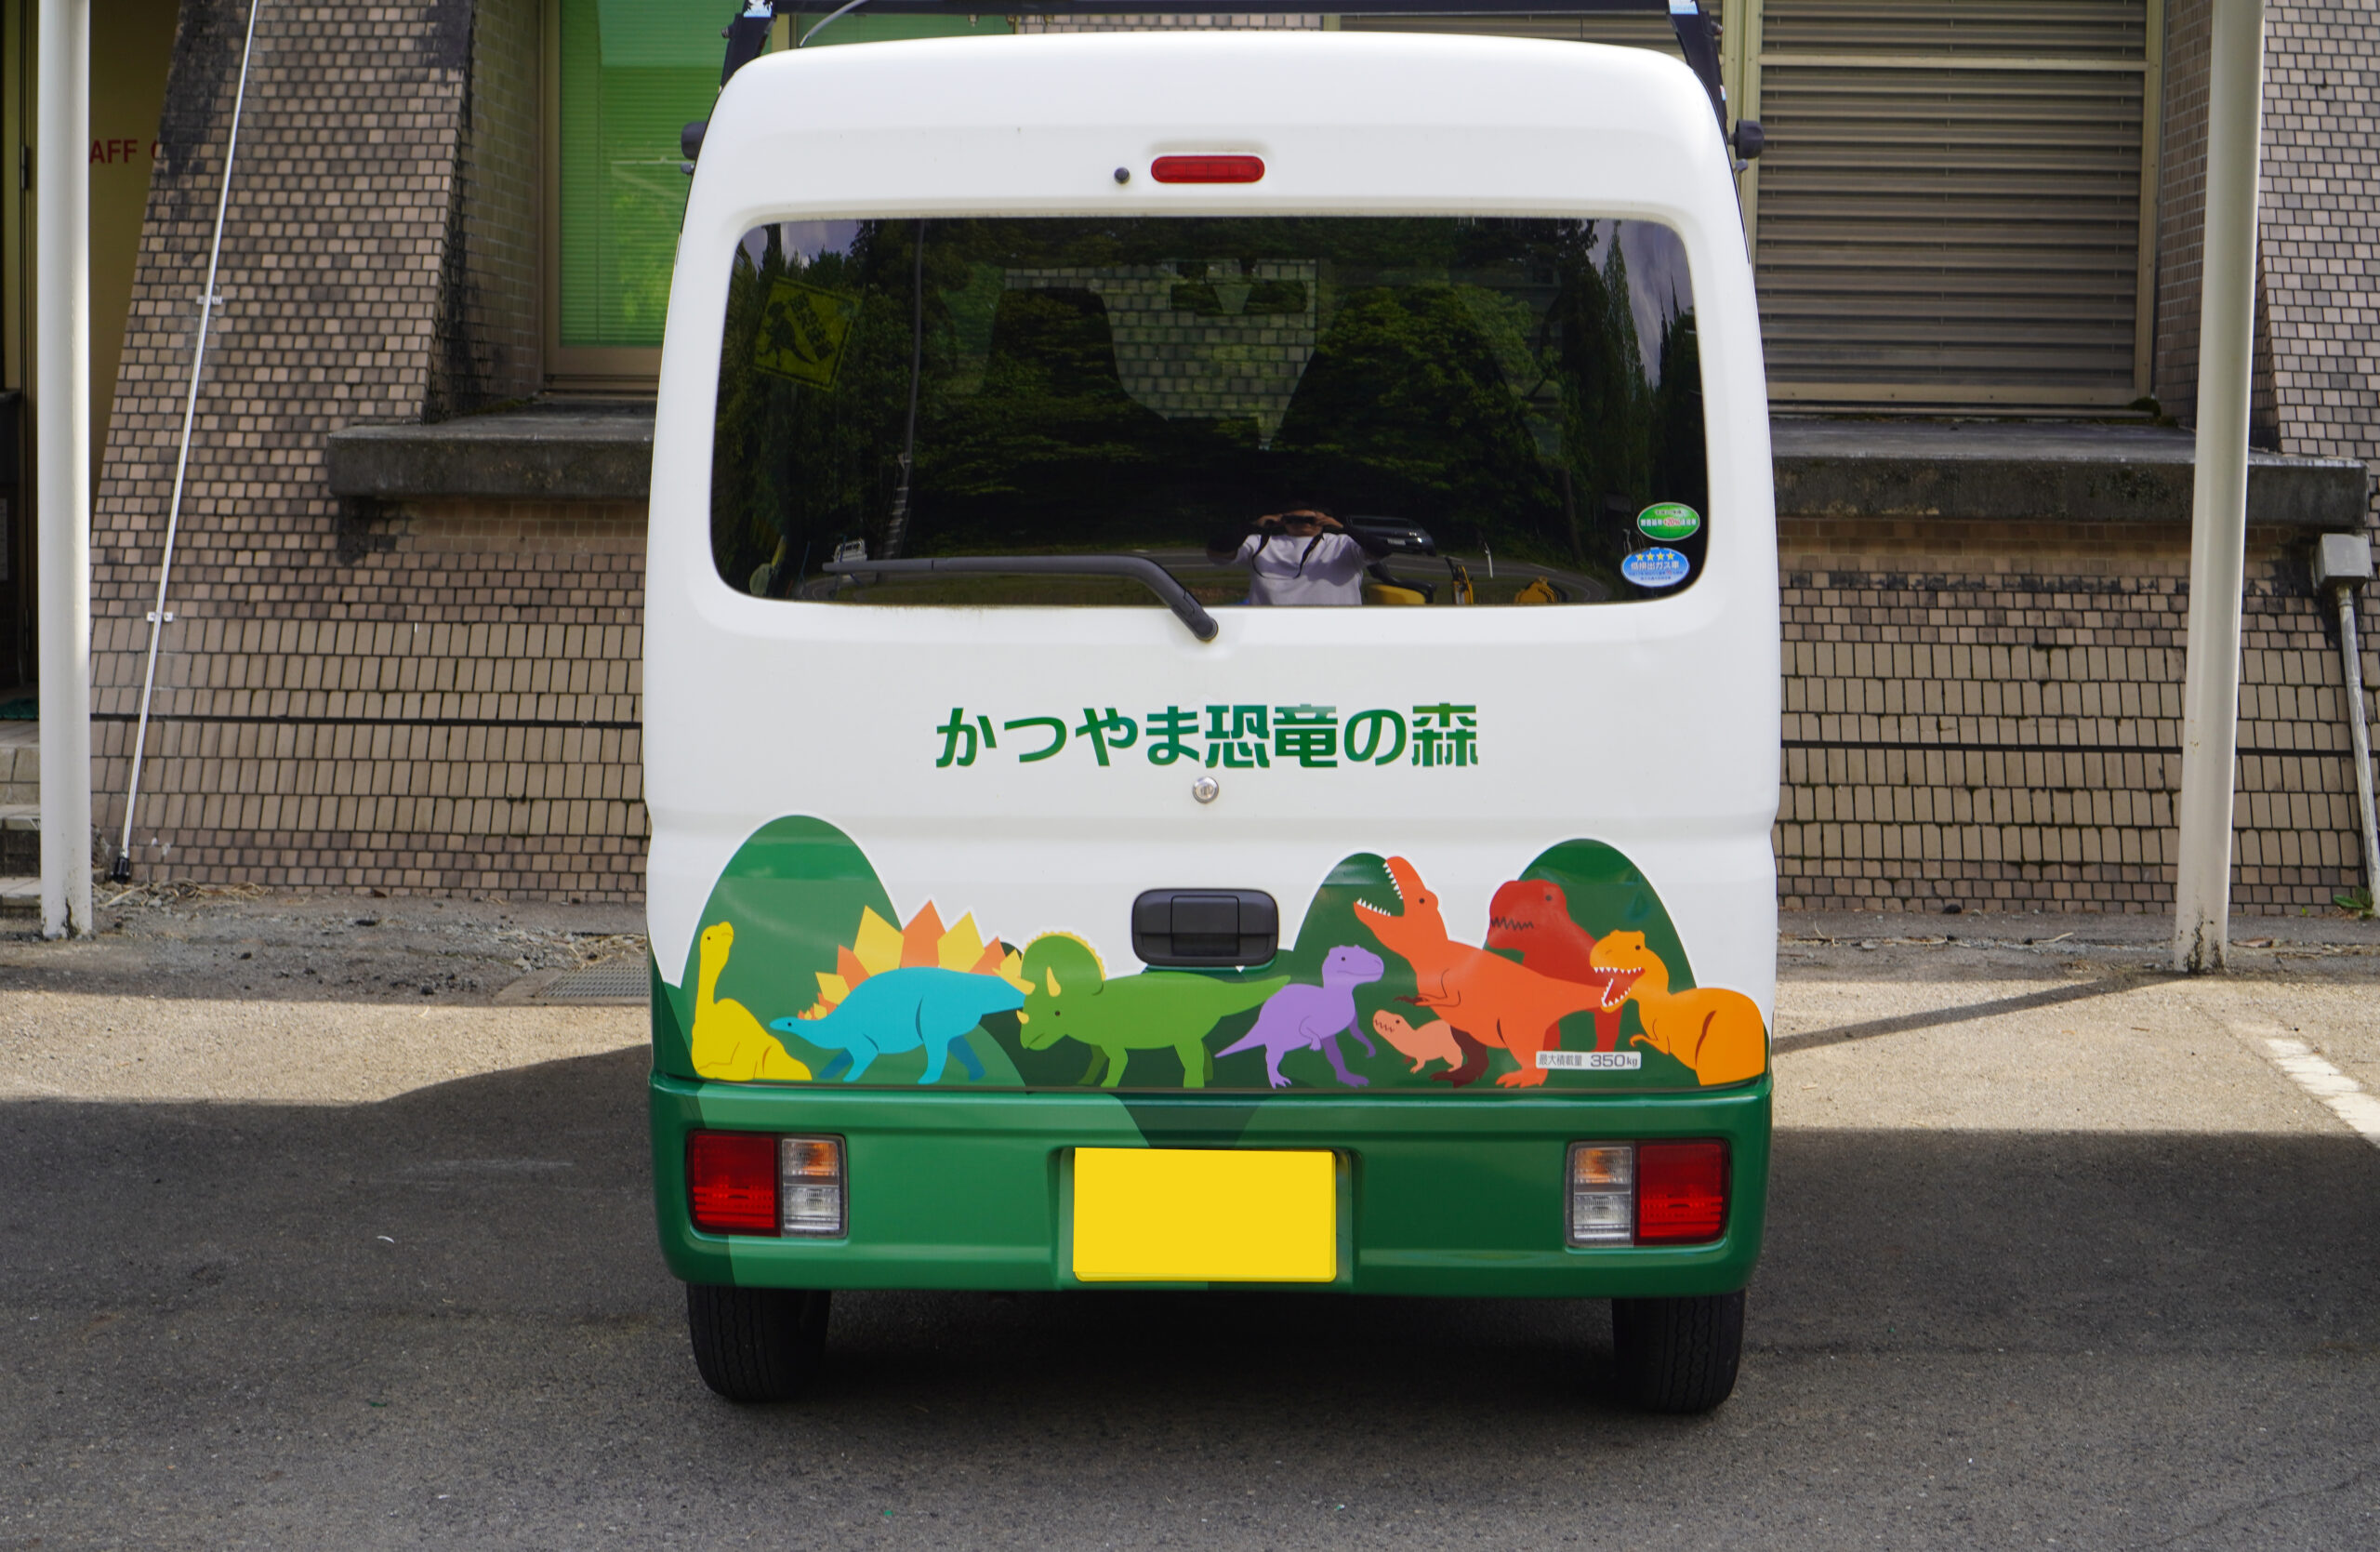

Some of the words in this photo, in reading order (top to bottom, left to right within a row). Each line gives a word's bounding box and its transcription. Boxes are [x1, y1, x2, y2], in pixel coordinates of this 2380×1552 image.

[935, 702, 1477, 768] かつやま恐竜の森
[1539, 1054, 1582, 1067] 最大積載量
[1590, 1054, 1638, 1068] 350kg
